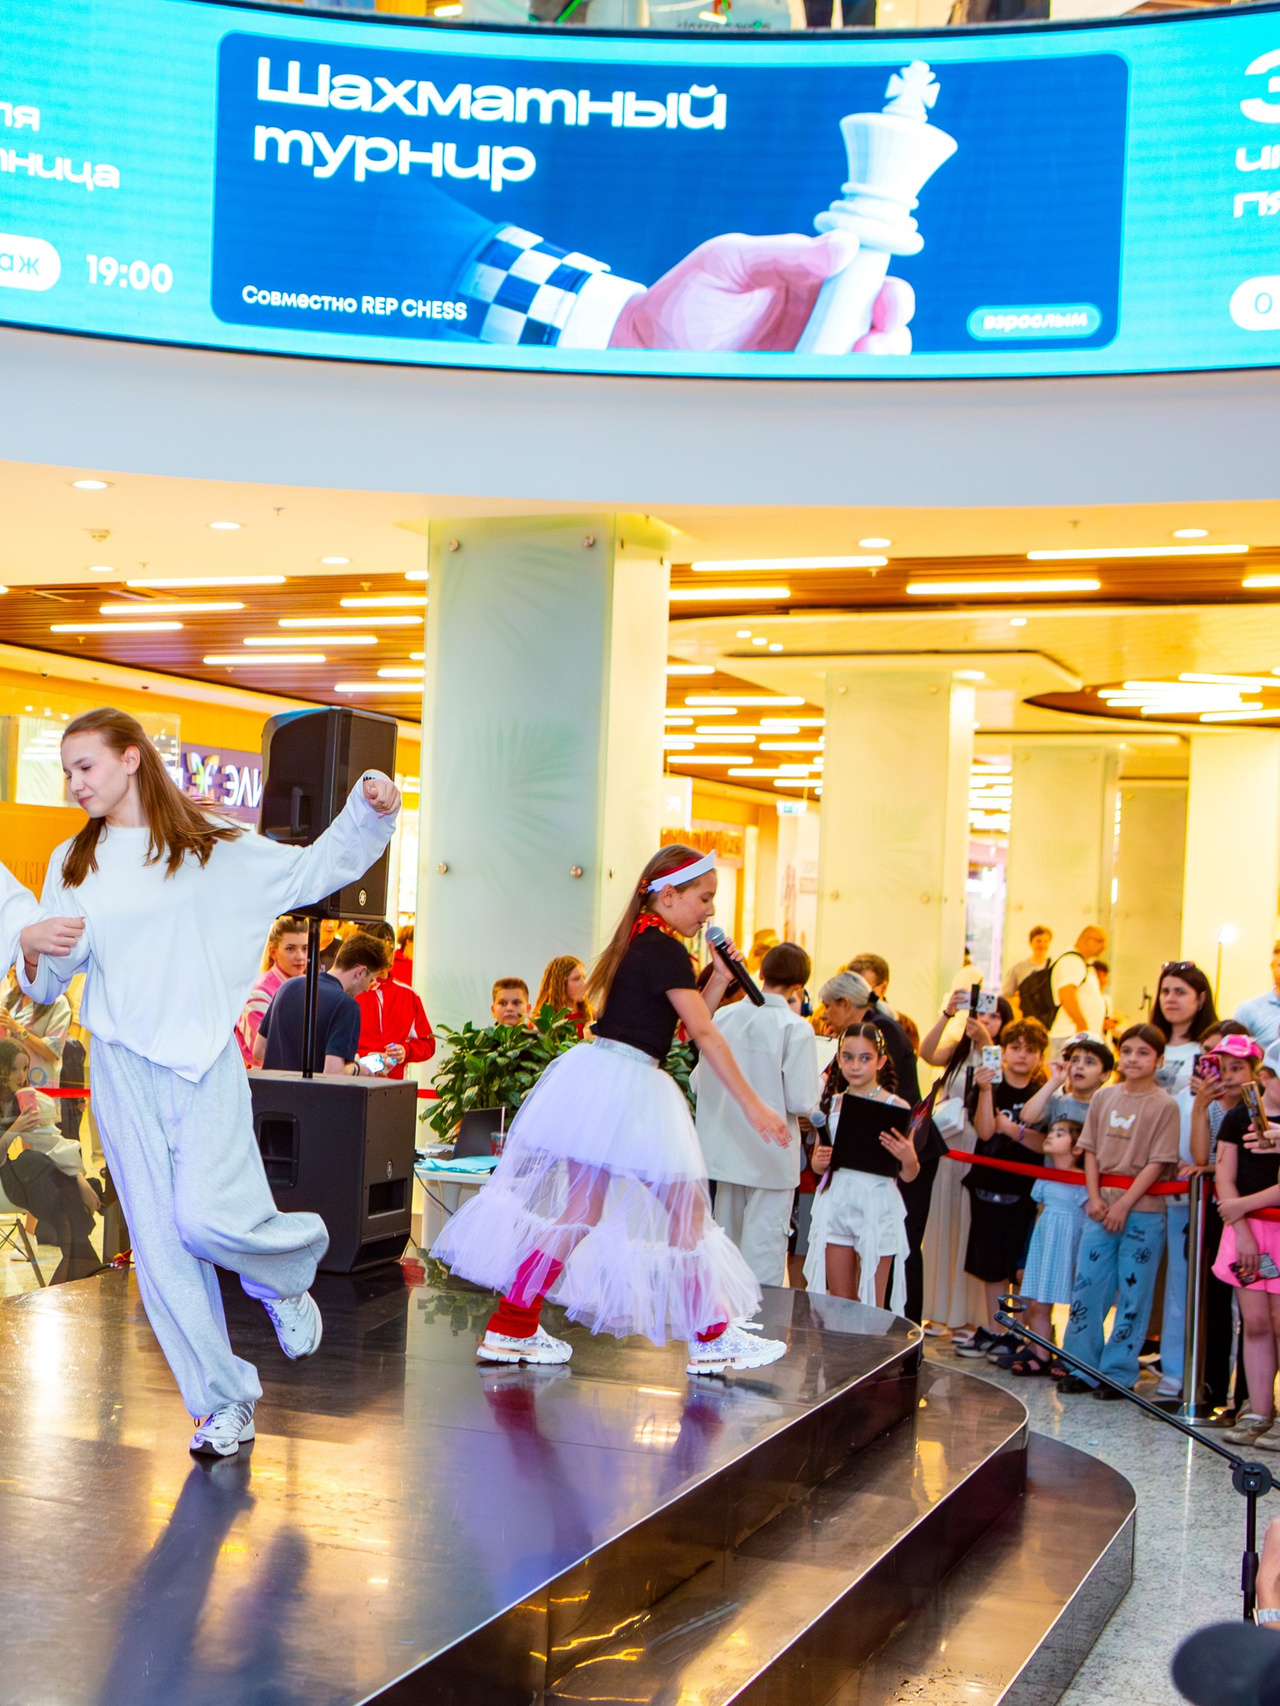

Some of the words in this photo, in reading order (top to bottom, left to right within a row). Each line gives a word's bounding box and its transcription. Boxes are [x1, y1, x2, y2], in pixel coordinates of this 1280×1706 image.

[257, 56, 728, 131] Шахматный
[253, 124, 538, 192] турнир
[86, 254, 174, 293] 19:00
[361, 295, 399, 316] REP
[401, 299, 468, 321] CHESS
[982, 312, 1088, 333] взрослым
